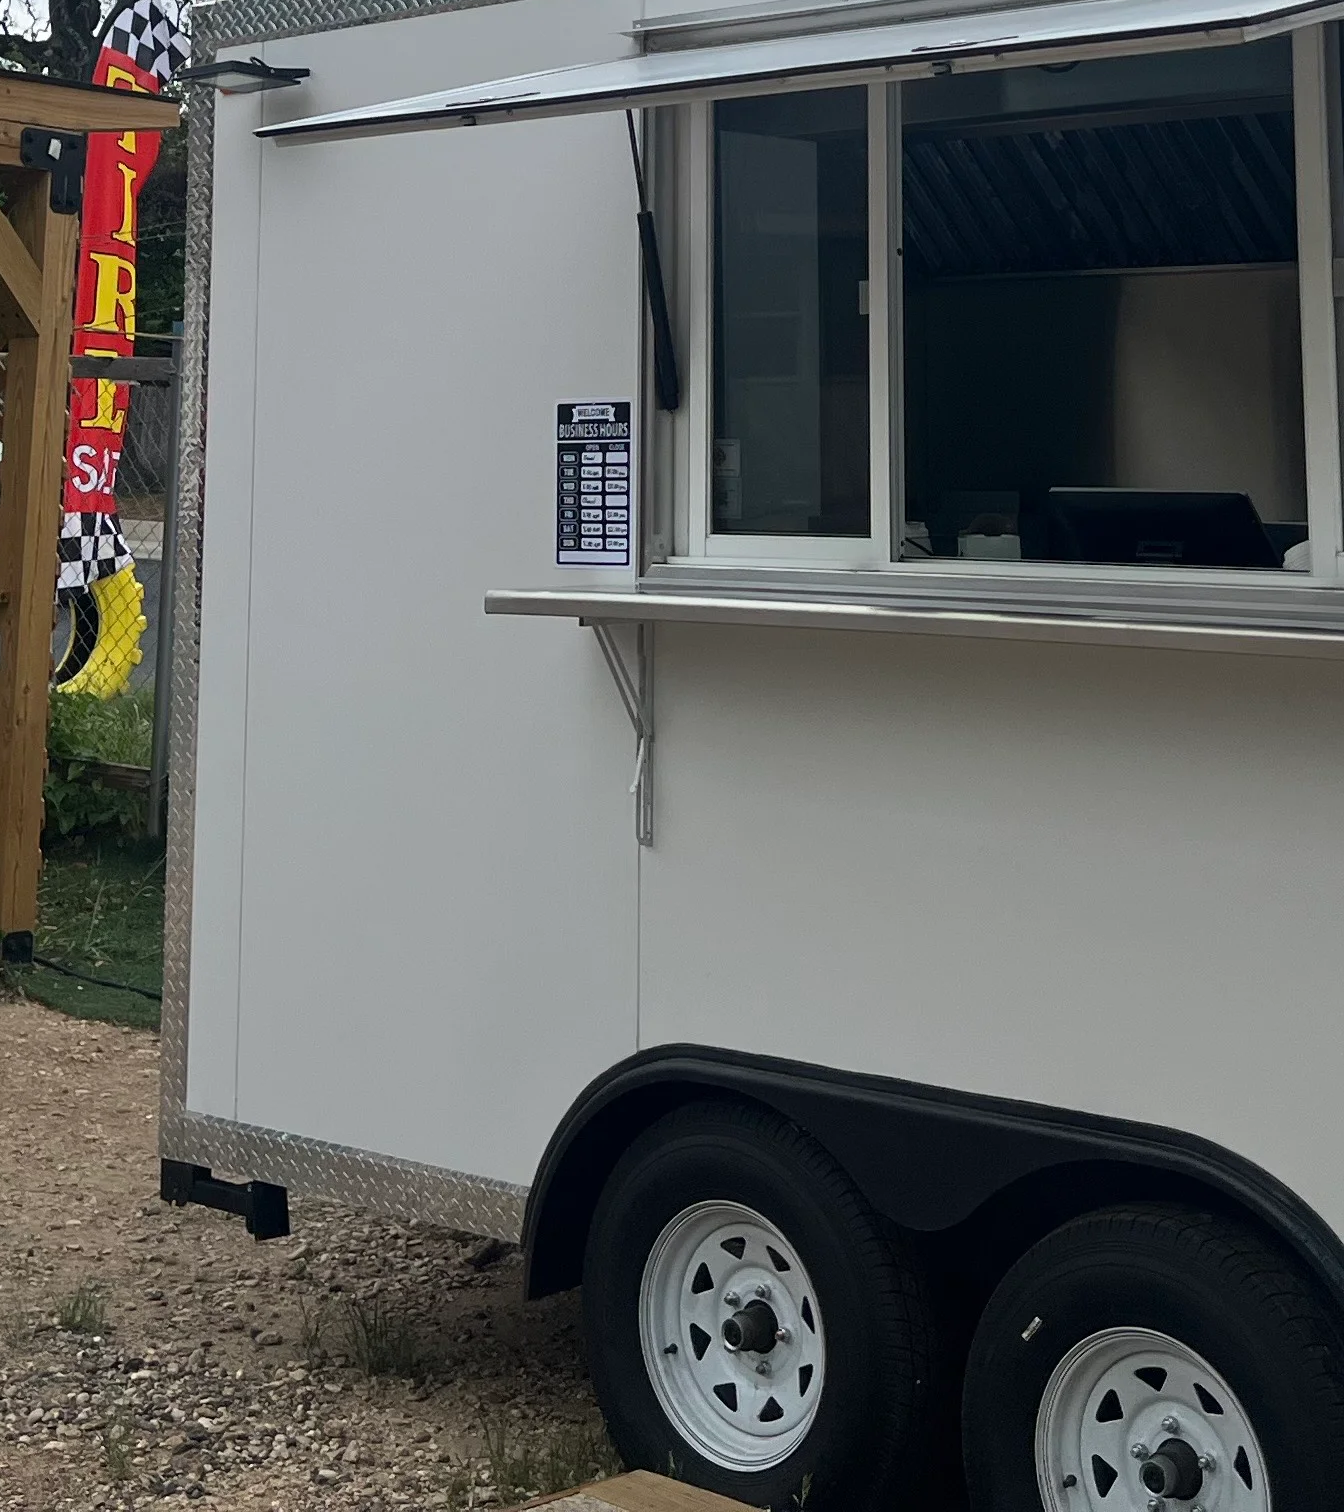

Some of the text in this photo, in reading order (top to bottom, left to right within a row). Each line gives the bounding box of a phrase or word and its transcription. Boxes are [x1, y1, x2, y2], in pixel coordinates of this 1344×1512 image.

[577, 407, 610, 417] WELCOME
[559, 422, 628, 438] BUSINESS HOURS
